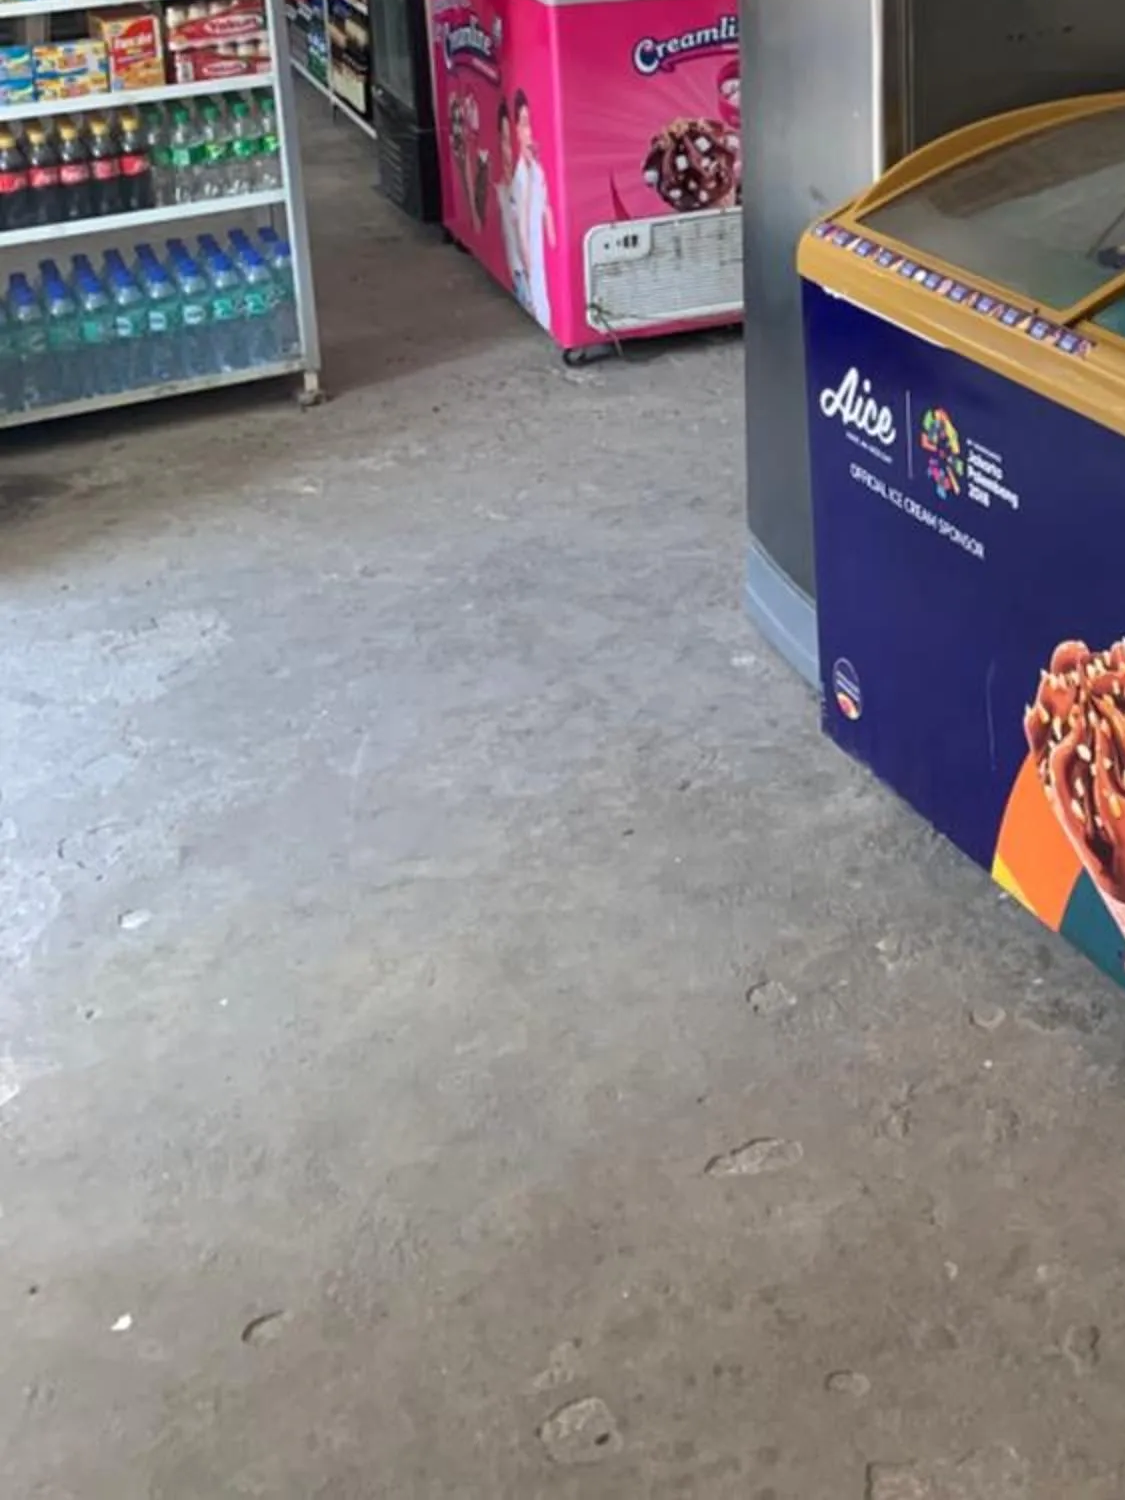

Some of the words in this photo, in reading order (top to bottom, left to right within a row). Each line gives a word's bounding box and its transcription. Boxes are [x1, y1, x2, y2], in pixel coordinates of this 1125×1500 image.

[634, 15, 738, 73] Creamli
[820, 366, 897, 445] Aice
[849, 461, 888, 500] OFFICIAL
[888, 488, 904, 509] ICE
[904, 496, 937, 530] CREAM
[937, 518, 985, 560] SPONSOR
